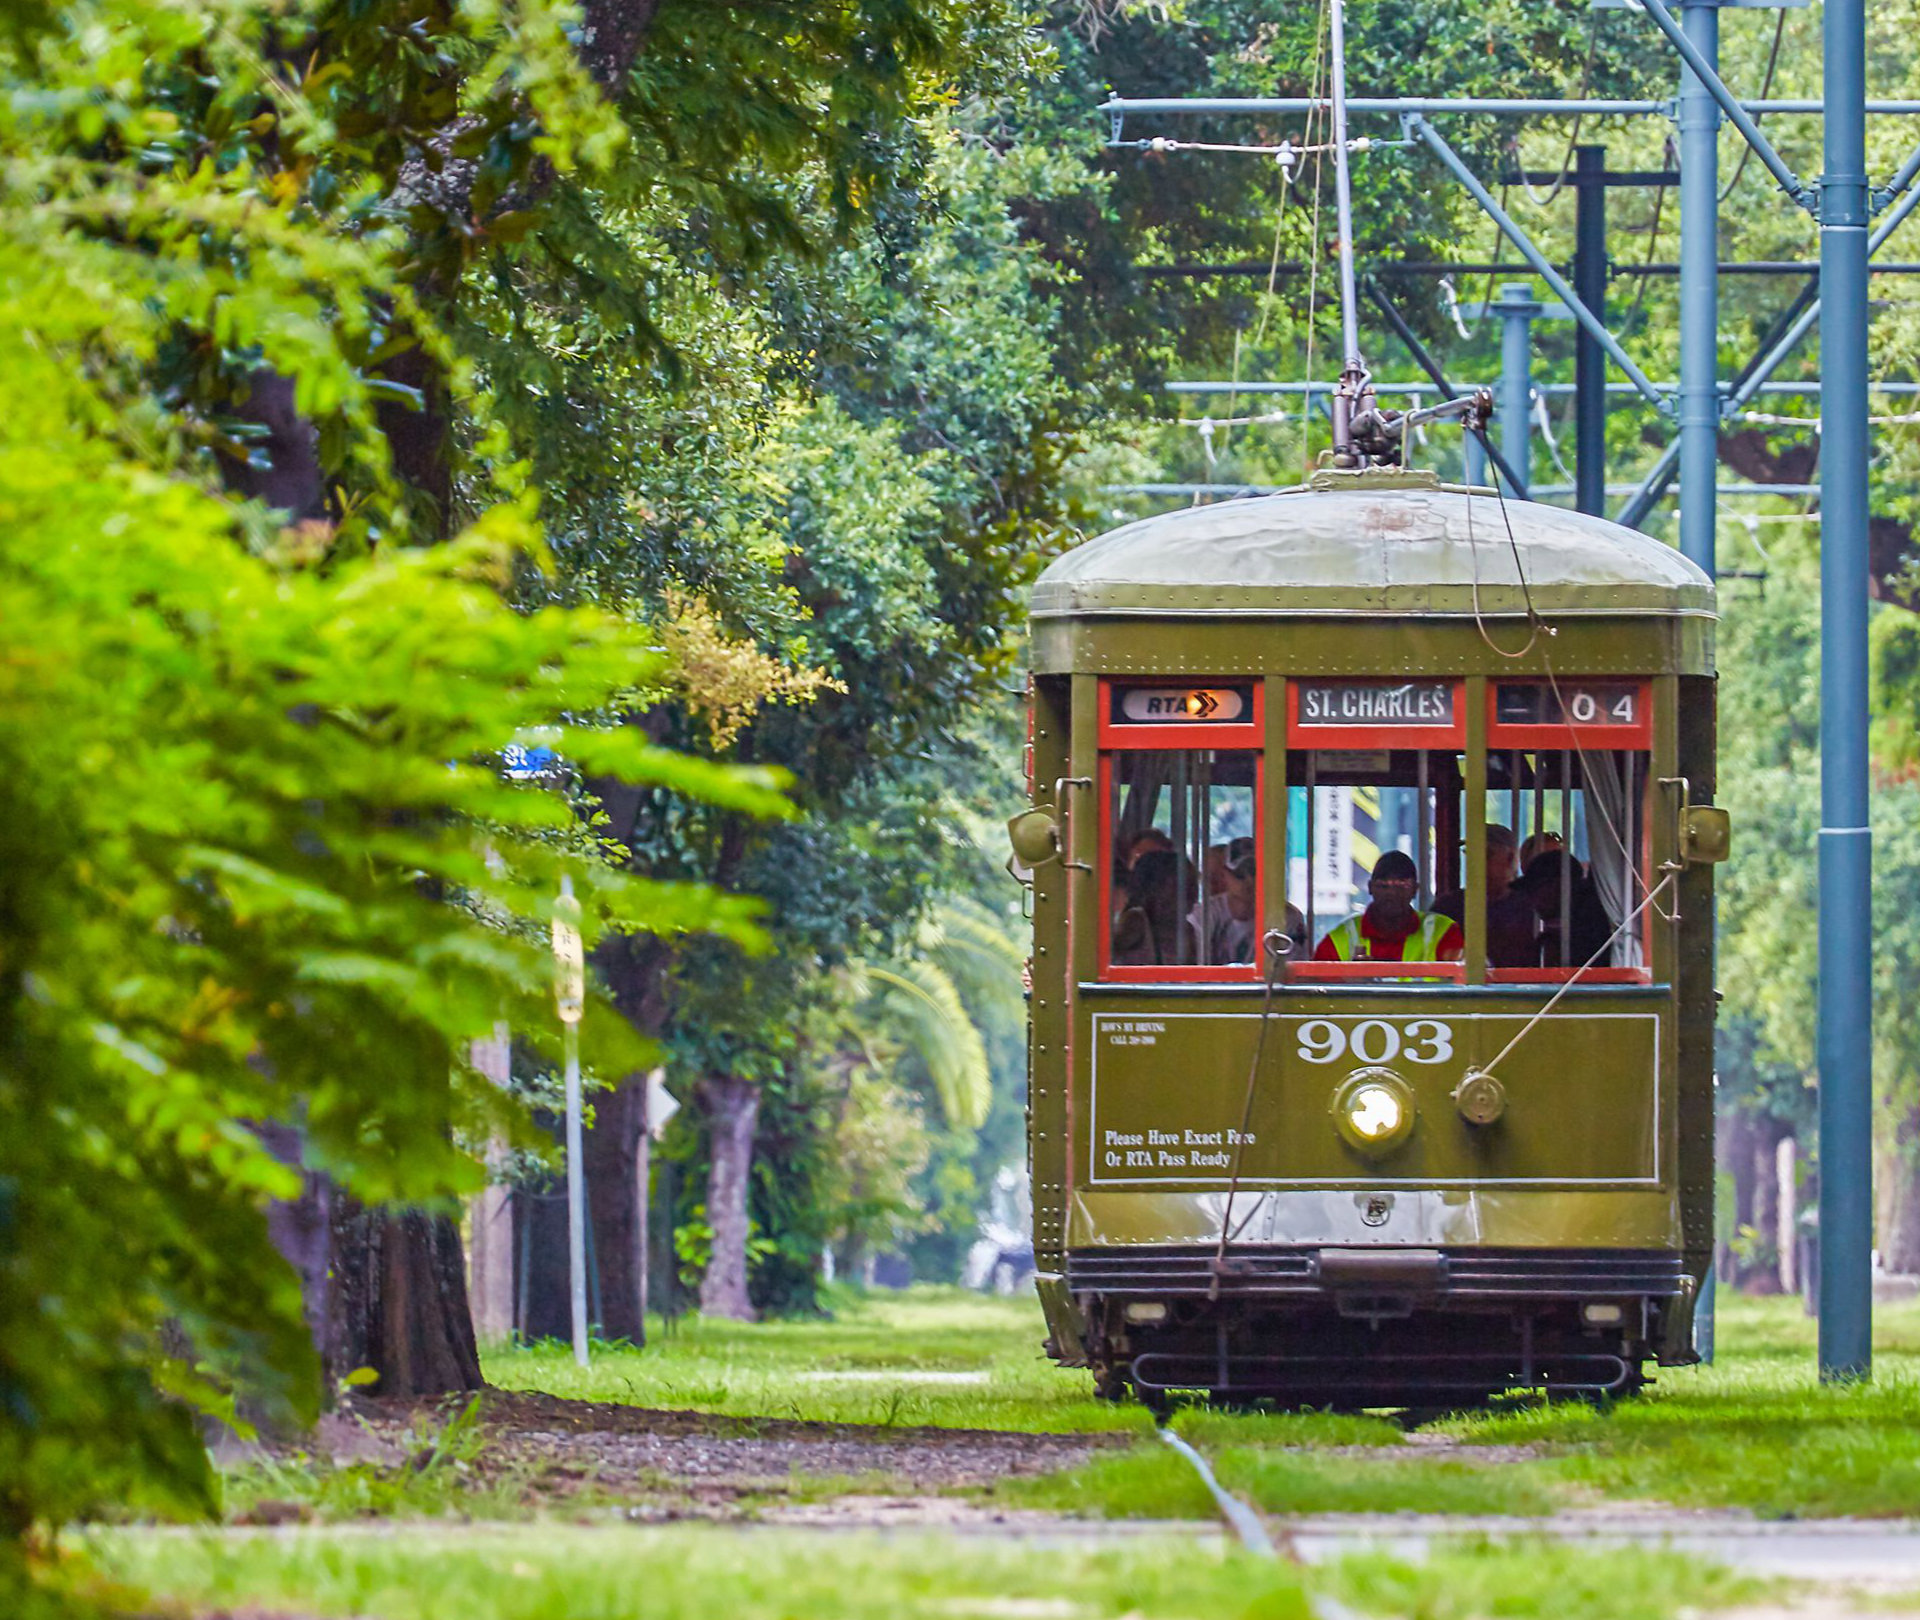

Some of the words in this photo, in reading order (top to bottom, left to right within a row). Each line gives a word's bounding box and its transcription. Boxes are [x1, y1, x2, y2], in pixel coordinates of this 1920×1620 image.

[1147, 697, 1188, 713] RTA
[1306, 689, 1336, 717] ST.
[1342, 689, 1445, 717] CHARLES
[1297, 1020, 1453, 1064] 903
[1105, 1130, 1143, 1146] Please
[1148, 1130, 1179, 1145] Have
[1184, 1129, 1222, 1145] Exact
[1105, 1151, 1122, 1167] Or
[1127, 1151, 1153, 1166] RTA
[1158, 1151, 1186, 1166] Pass
[1191, 1150, 1231, 1168] Ready
